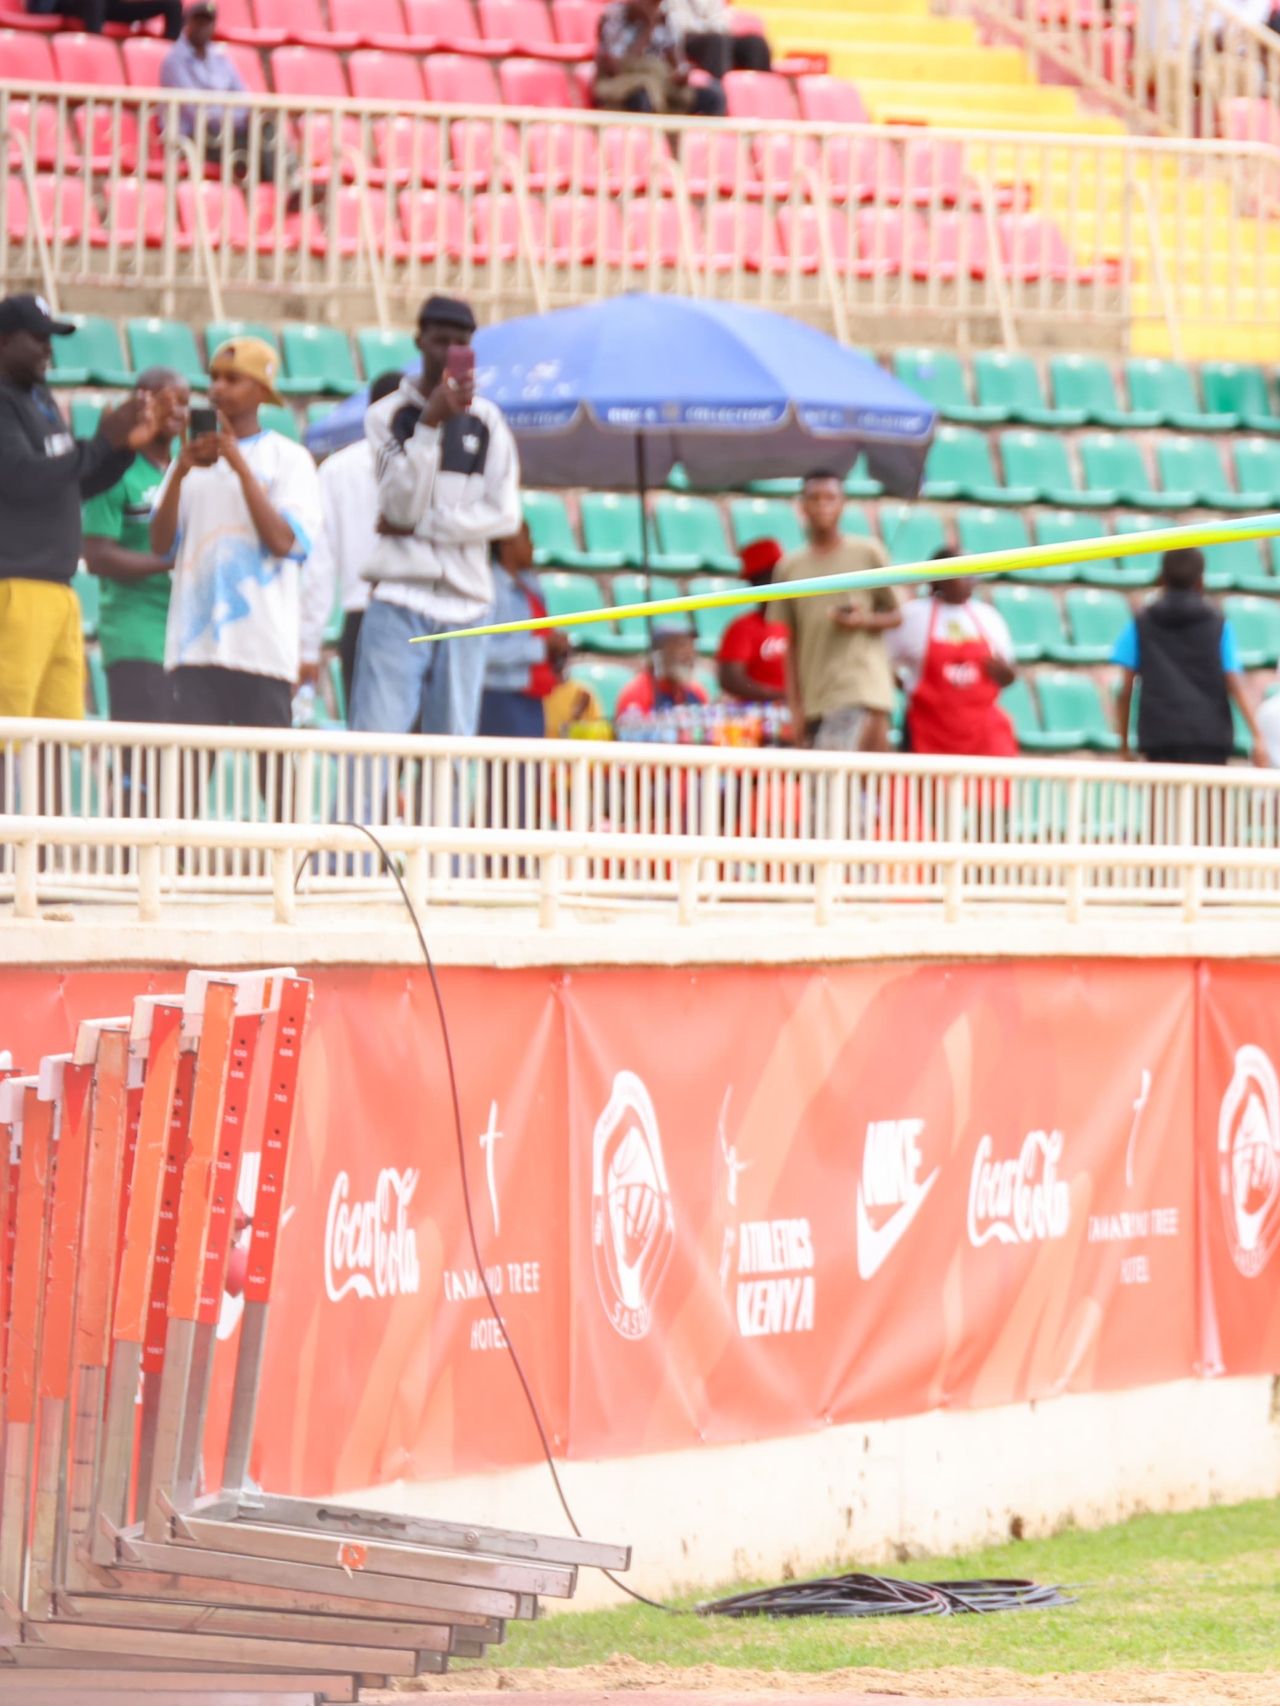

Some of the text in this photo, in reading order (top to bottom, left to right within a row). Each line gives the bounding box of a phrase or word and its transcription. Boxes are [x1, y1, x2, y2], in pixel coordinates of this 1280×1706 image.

[862, 1118, 925, 1206] NIKE
[967, 1129, 1070, 1248] Coca-Cola
[324, 1167, 420, 1302] Coca-Cola
[738, 1218, 815, 1274] ATHLETICS
[507, 1262, 540, 1293] TREE
[737, 1276, 815, 1337] KENYA
